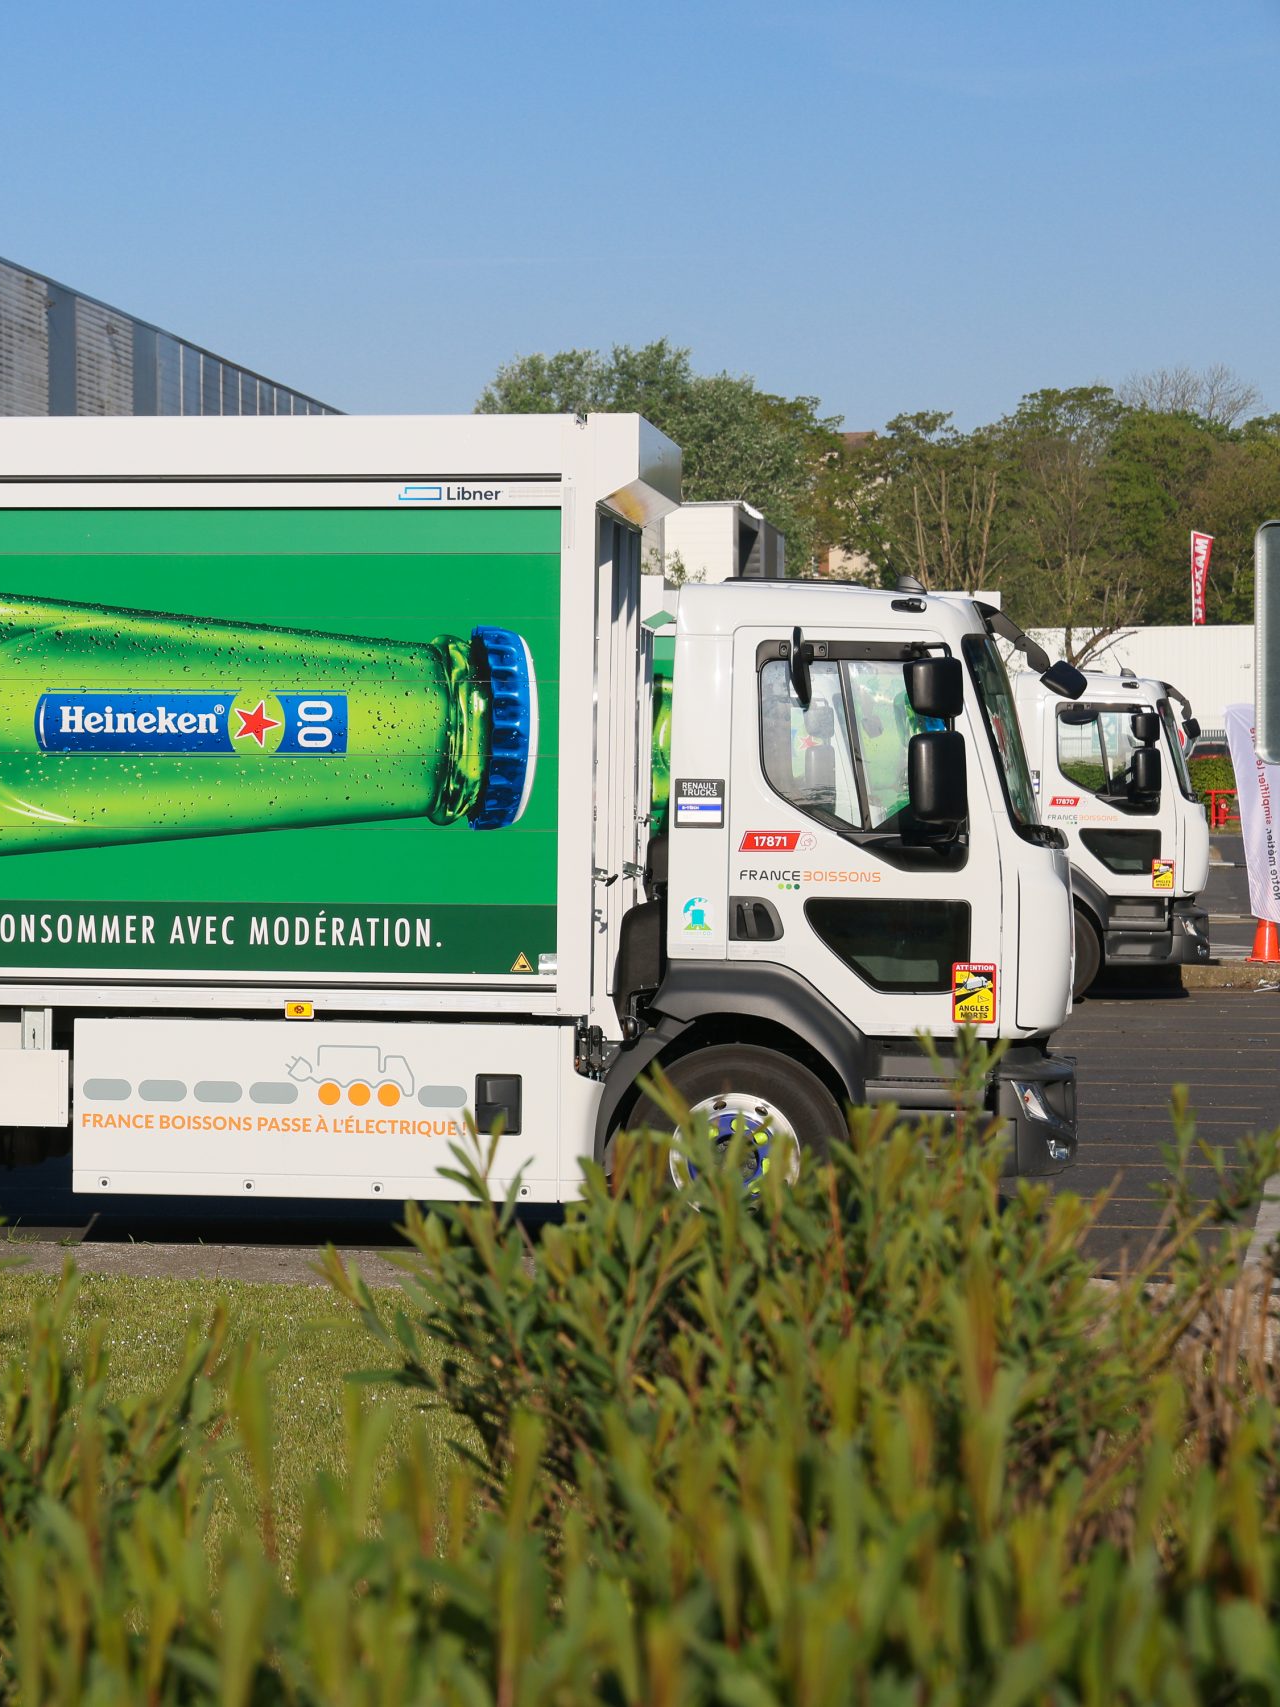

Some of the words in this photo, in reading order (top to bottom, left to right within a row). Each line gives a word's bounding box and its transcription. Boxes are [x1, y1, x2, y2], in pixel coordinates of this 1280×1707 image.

[446, 486, 501, 501] Libner
[297, 700, 333, 748] 0.0
[682, 782, 718, 790] RENAULT
[753, 835, 788, 847] 17871
[739, 869, 801, 881] FRANCE
[803, 870, 881, 883] BOISSONS
[169, 914, 236, 946] AVEC
[249, 911, 443, 948] MODÉRATION.
[81, 1112, 156, 1130] FRANCE
[159, 1114, 253, 1132] BOISSONS
[257, 1116, 312, 1133] PASSE
[315, 1114, 330, 1134] À
[333, 1113, 458, 1137] L'ÉLECTRIQUE
